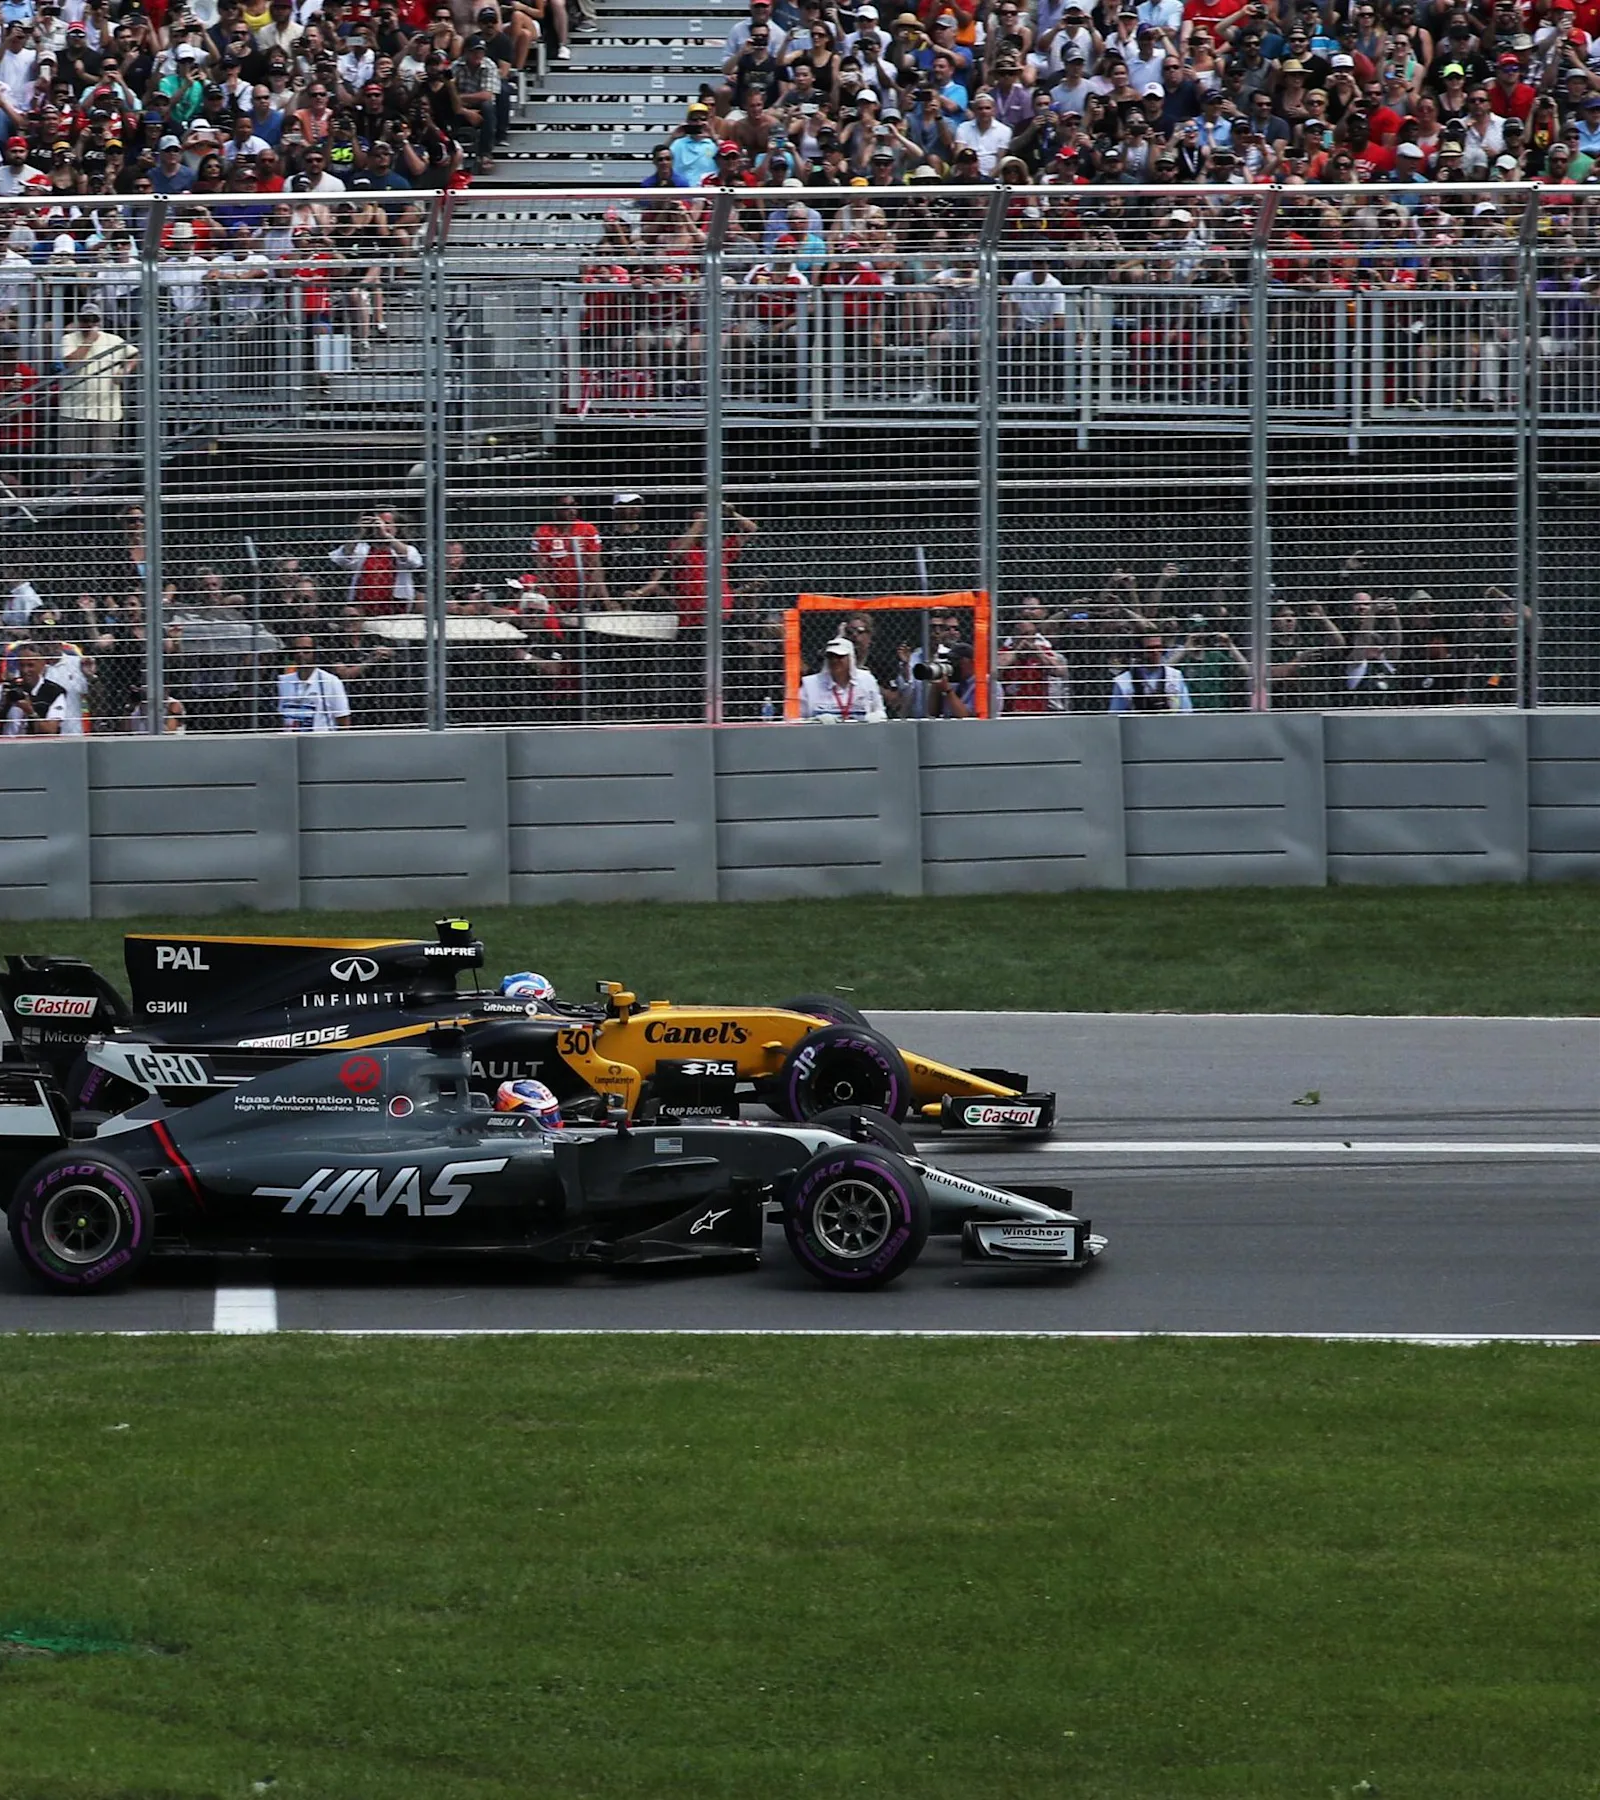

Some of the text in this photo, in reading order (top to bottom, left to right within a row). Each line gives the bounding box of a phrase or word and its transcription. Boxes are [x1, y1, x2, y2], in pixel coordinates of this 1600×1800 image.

[156, 946, 210, 971] PAL
[424, 947, 476, 957] MAPFRE
[34, 997, 91, 1016] Castrol
[302, 991, 404, 1008] INFINITI
[483, 1002, 523, 1013] ultimate
[44, 1030, 89, 1044] Micros
[252, 1024, 350, 1048] Castrol EDGE
[561, 1030, 590, 1055] 30
[645, 1021, 748, 1045] Canel's
[834, 1037, 890, 1070] ZERO
[470, 1060, 544, 1079] AULT
[705, 1062, 736, 1076] R.S.
[793, 1046, 816, 1081] JP
[234, 1095, 380, 1105] Haas Automation Inc.
[234, 1104, 255, 1112] High
[686, 1105, 722, 1116] RACING
[982, 1107, 1036, 1125] Castrol
[33, 1165, 97, 1199] ZERO
[251, 1157, 510, 1216] HAAS
[924, 1169, 1013, 1207] RICHARD MILLE
[1002, 1227, 1066, 1237] Windshear
